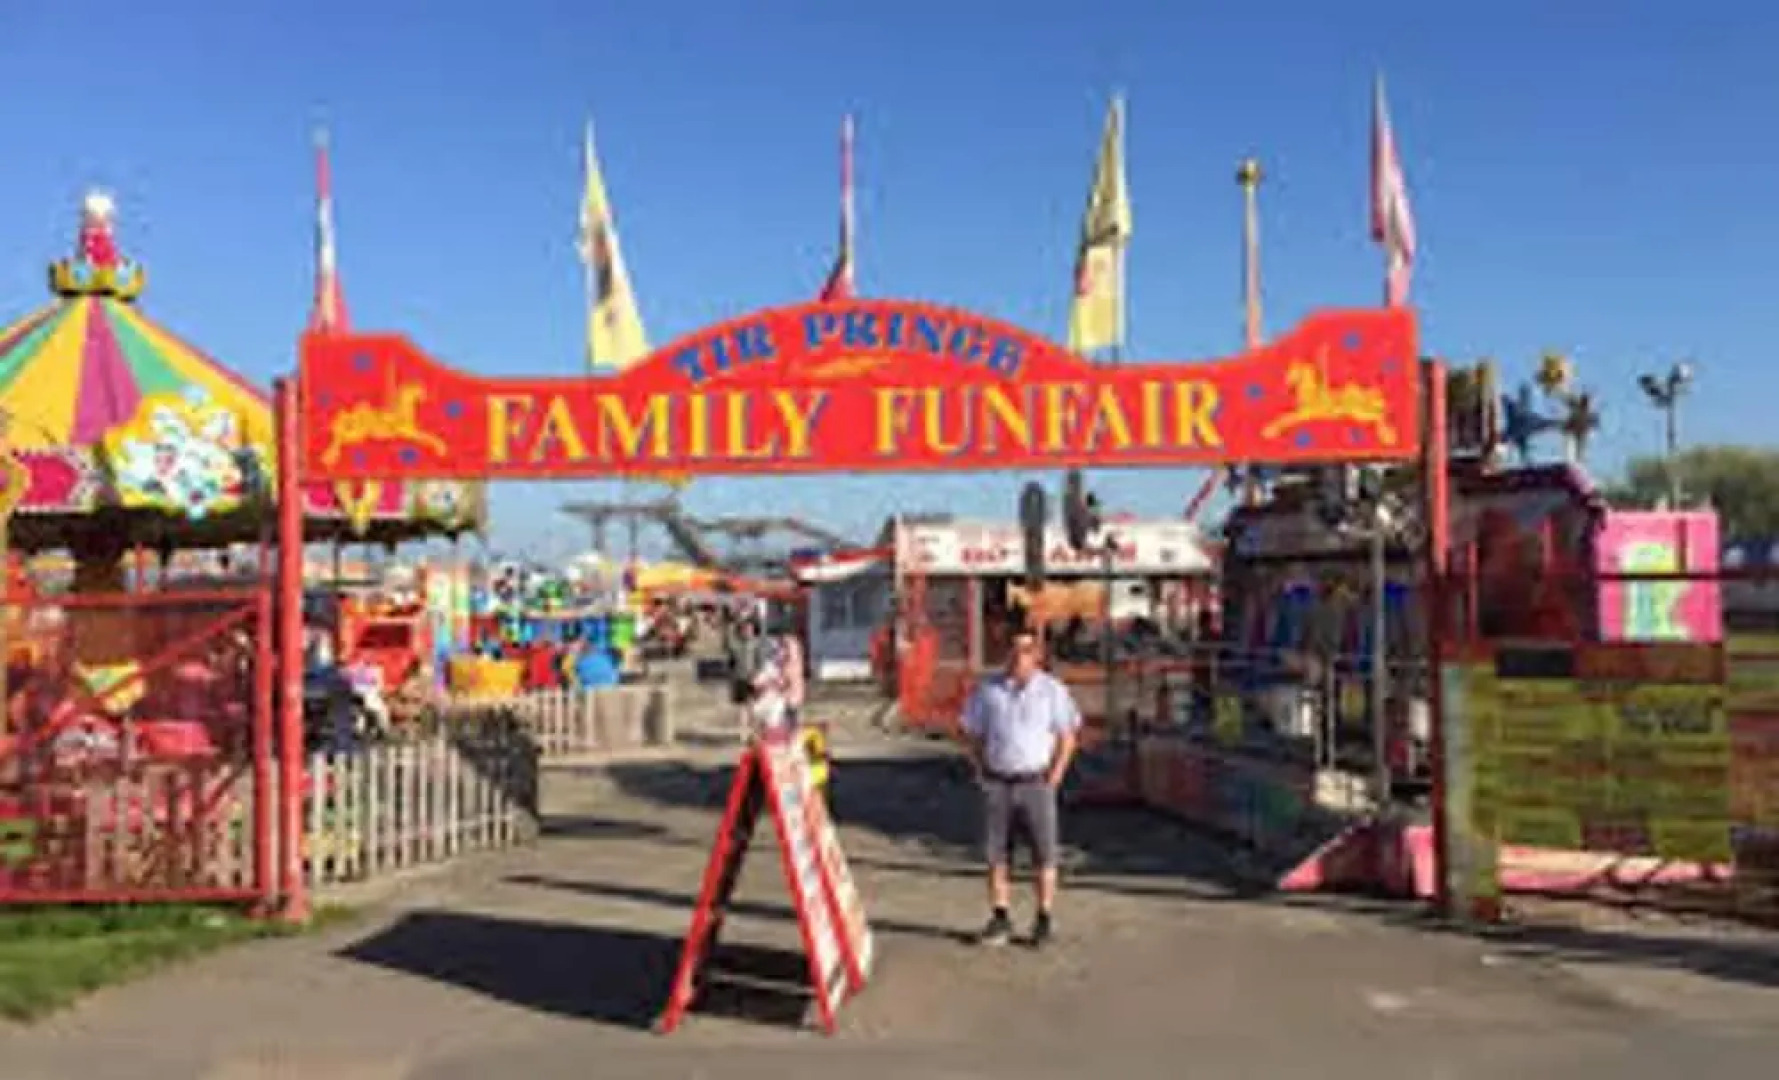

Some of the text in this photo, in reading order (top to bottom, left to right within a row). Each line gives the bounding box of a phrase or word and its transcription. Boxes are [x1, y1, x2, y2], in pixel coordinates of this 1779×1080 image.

[672, 311, 1025, 382] TIR PRINCE
[485, 380, 1224, 464] FAMILY FUNFAIR
